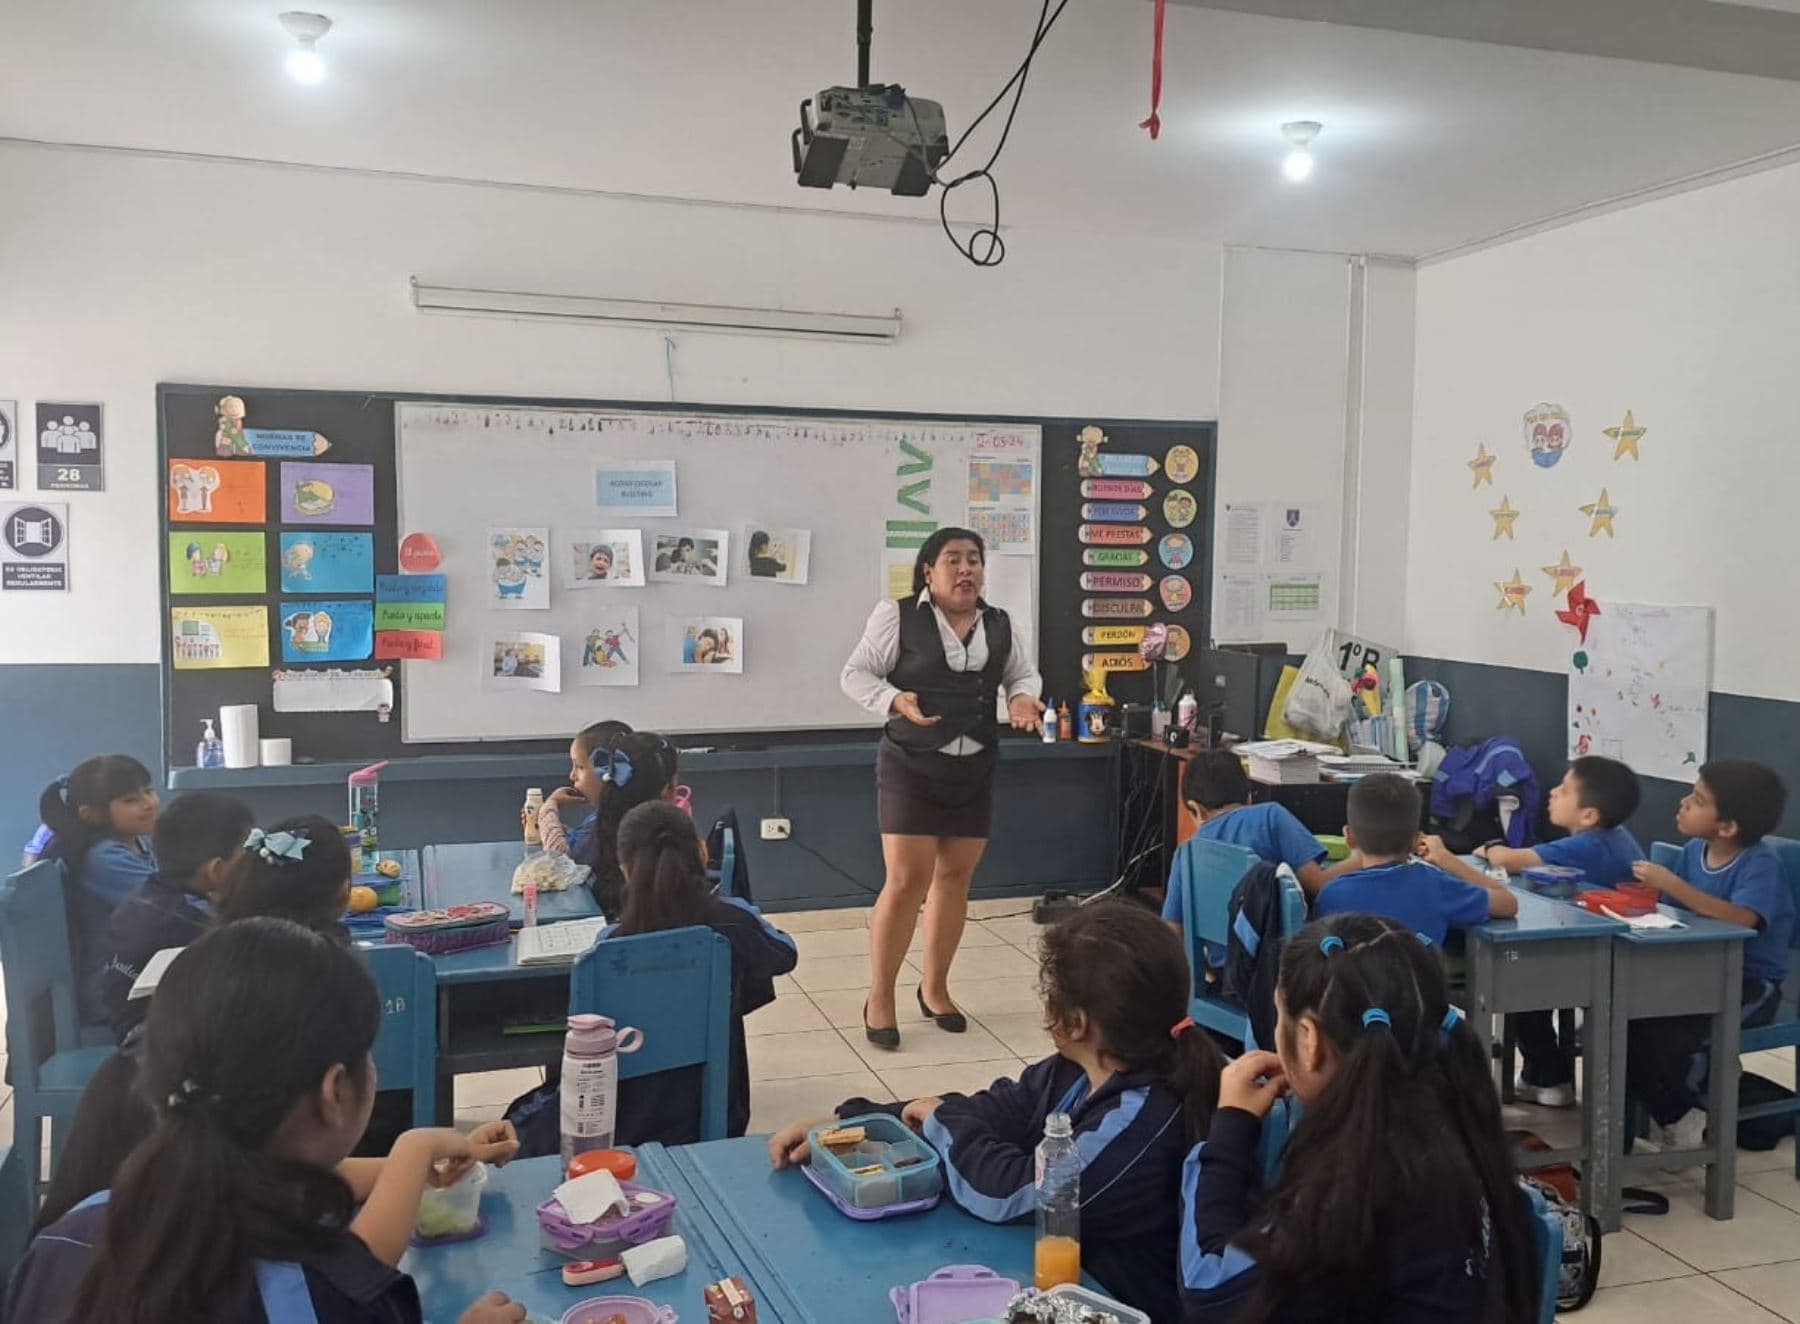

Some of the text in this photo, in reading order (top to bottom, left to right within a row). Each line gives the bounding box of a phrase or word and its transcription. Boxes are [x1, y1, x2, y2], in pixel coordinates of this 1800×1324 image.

[57, 468, 81, 482] 28
[1093, 575, 1141, 588] PERMISO
[1093, 602, 1144, 614] DISCULPA
